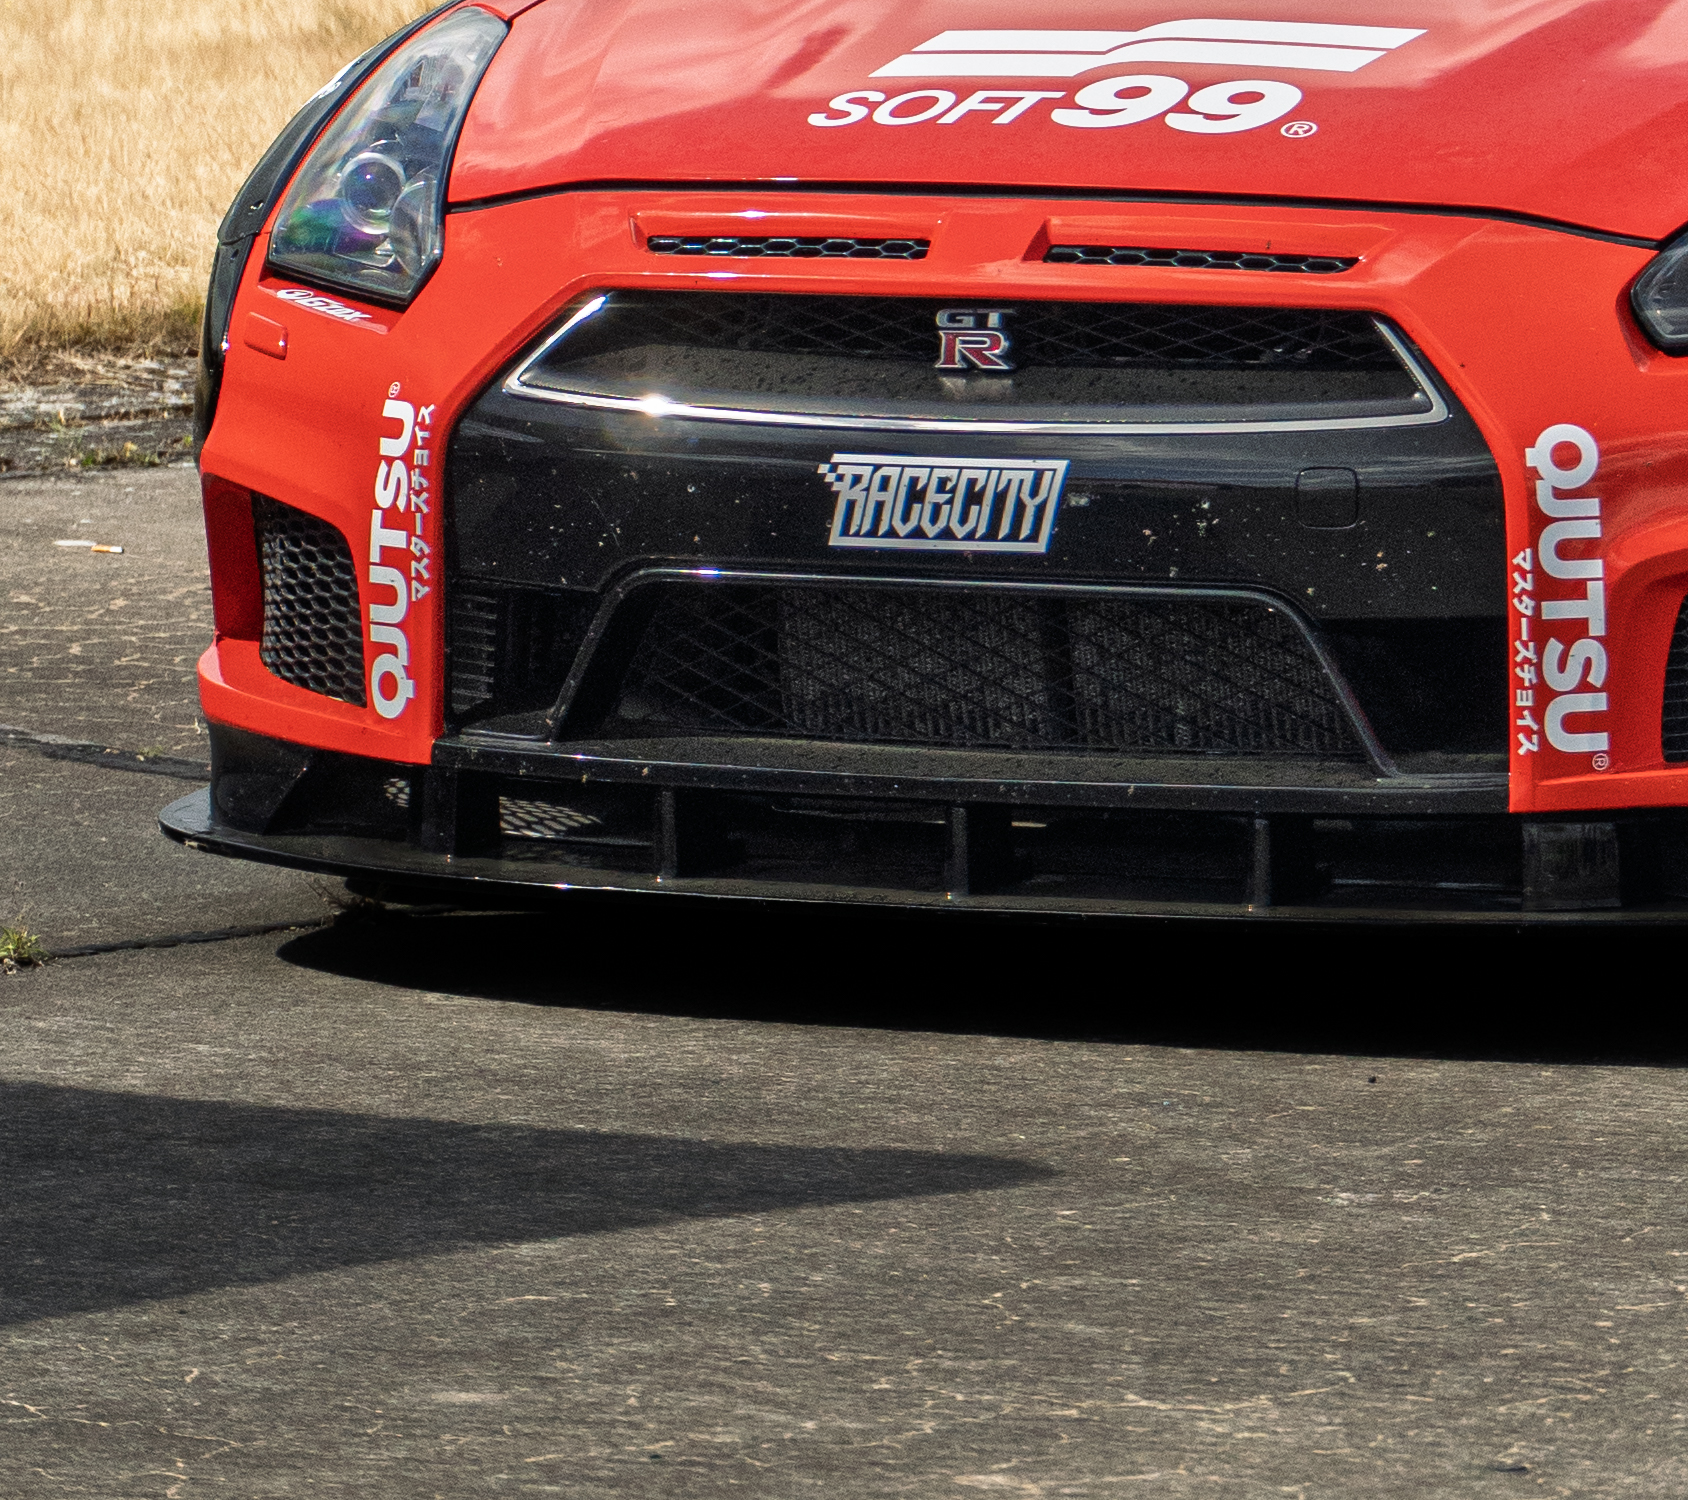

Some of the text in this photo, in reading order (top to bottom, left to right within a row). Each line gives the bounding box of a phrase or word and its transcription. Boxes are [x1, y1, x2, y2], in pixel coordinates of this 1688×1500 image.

[935, 307, 1016, 329] GT
[934, 330, 1013, 370] R
[830, 464, 1056, 541] RACECITY
